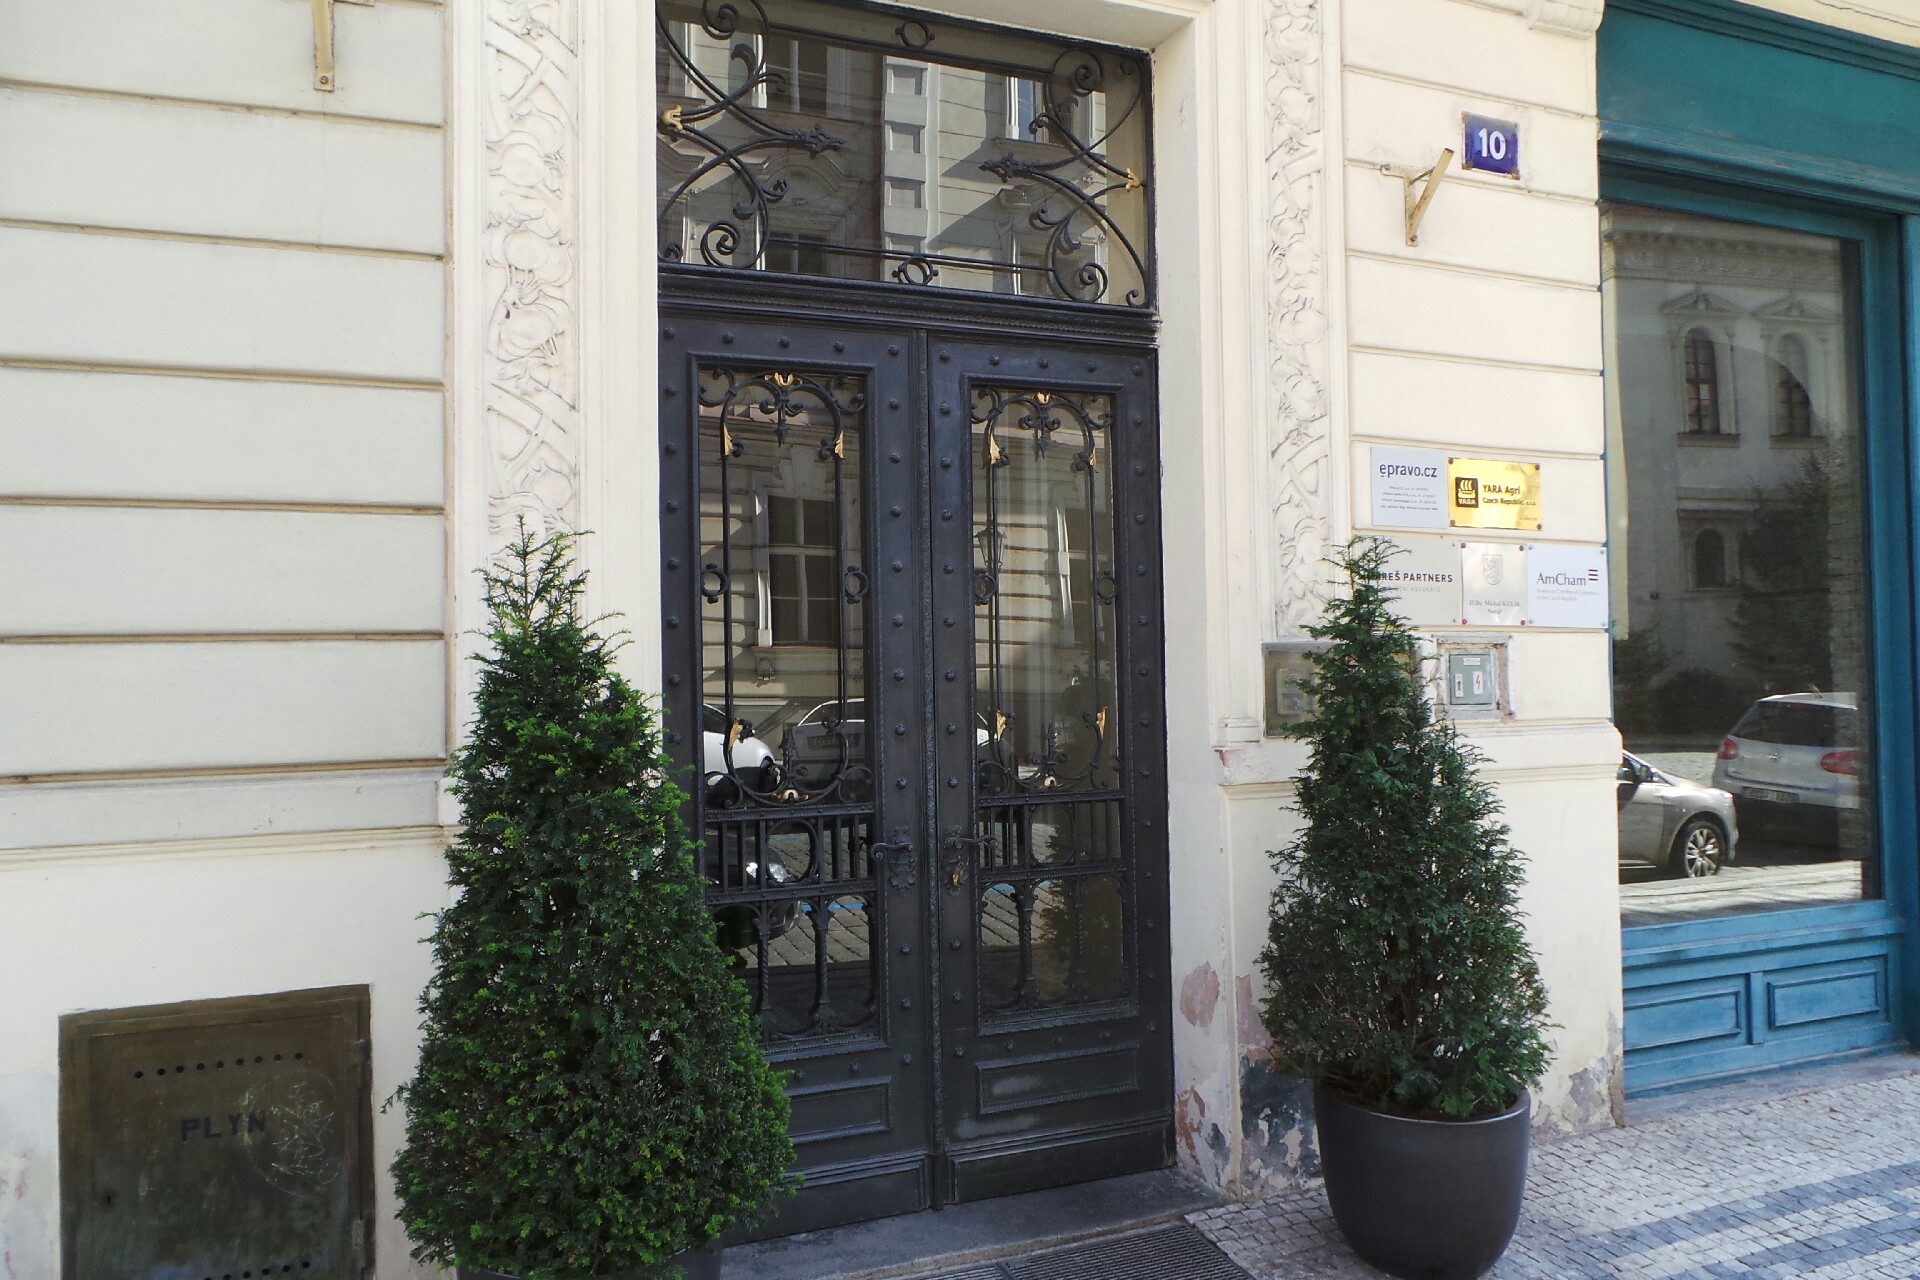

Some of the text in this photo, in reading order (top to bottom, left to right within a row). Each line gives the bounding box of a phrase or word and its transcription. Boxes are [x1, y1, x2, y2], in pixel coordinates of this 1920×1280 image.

[1479, 127, 1506, 160] 10
[1379, 464, 1438, 478] epravo.cz
[1482, 484, 1521, 496] YARA Agri
[1403, 572, 1453, 583] PARTNERS
[1537, 572, 1586, 586] AmCham
[181, 1110, 266, 1142] PLYN
